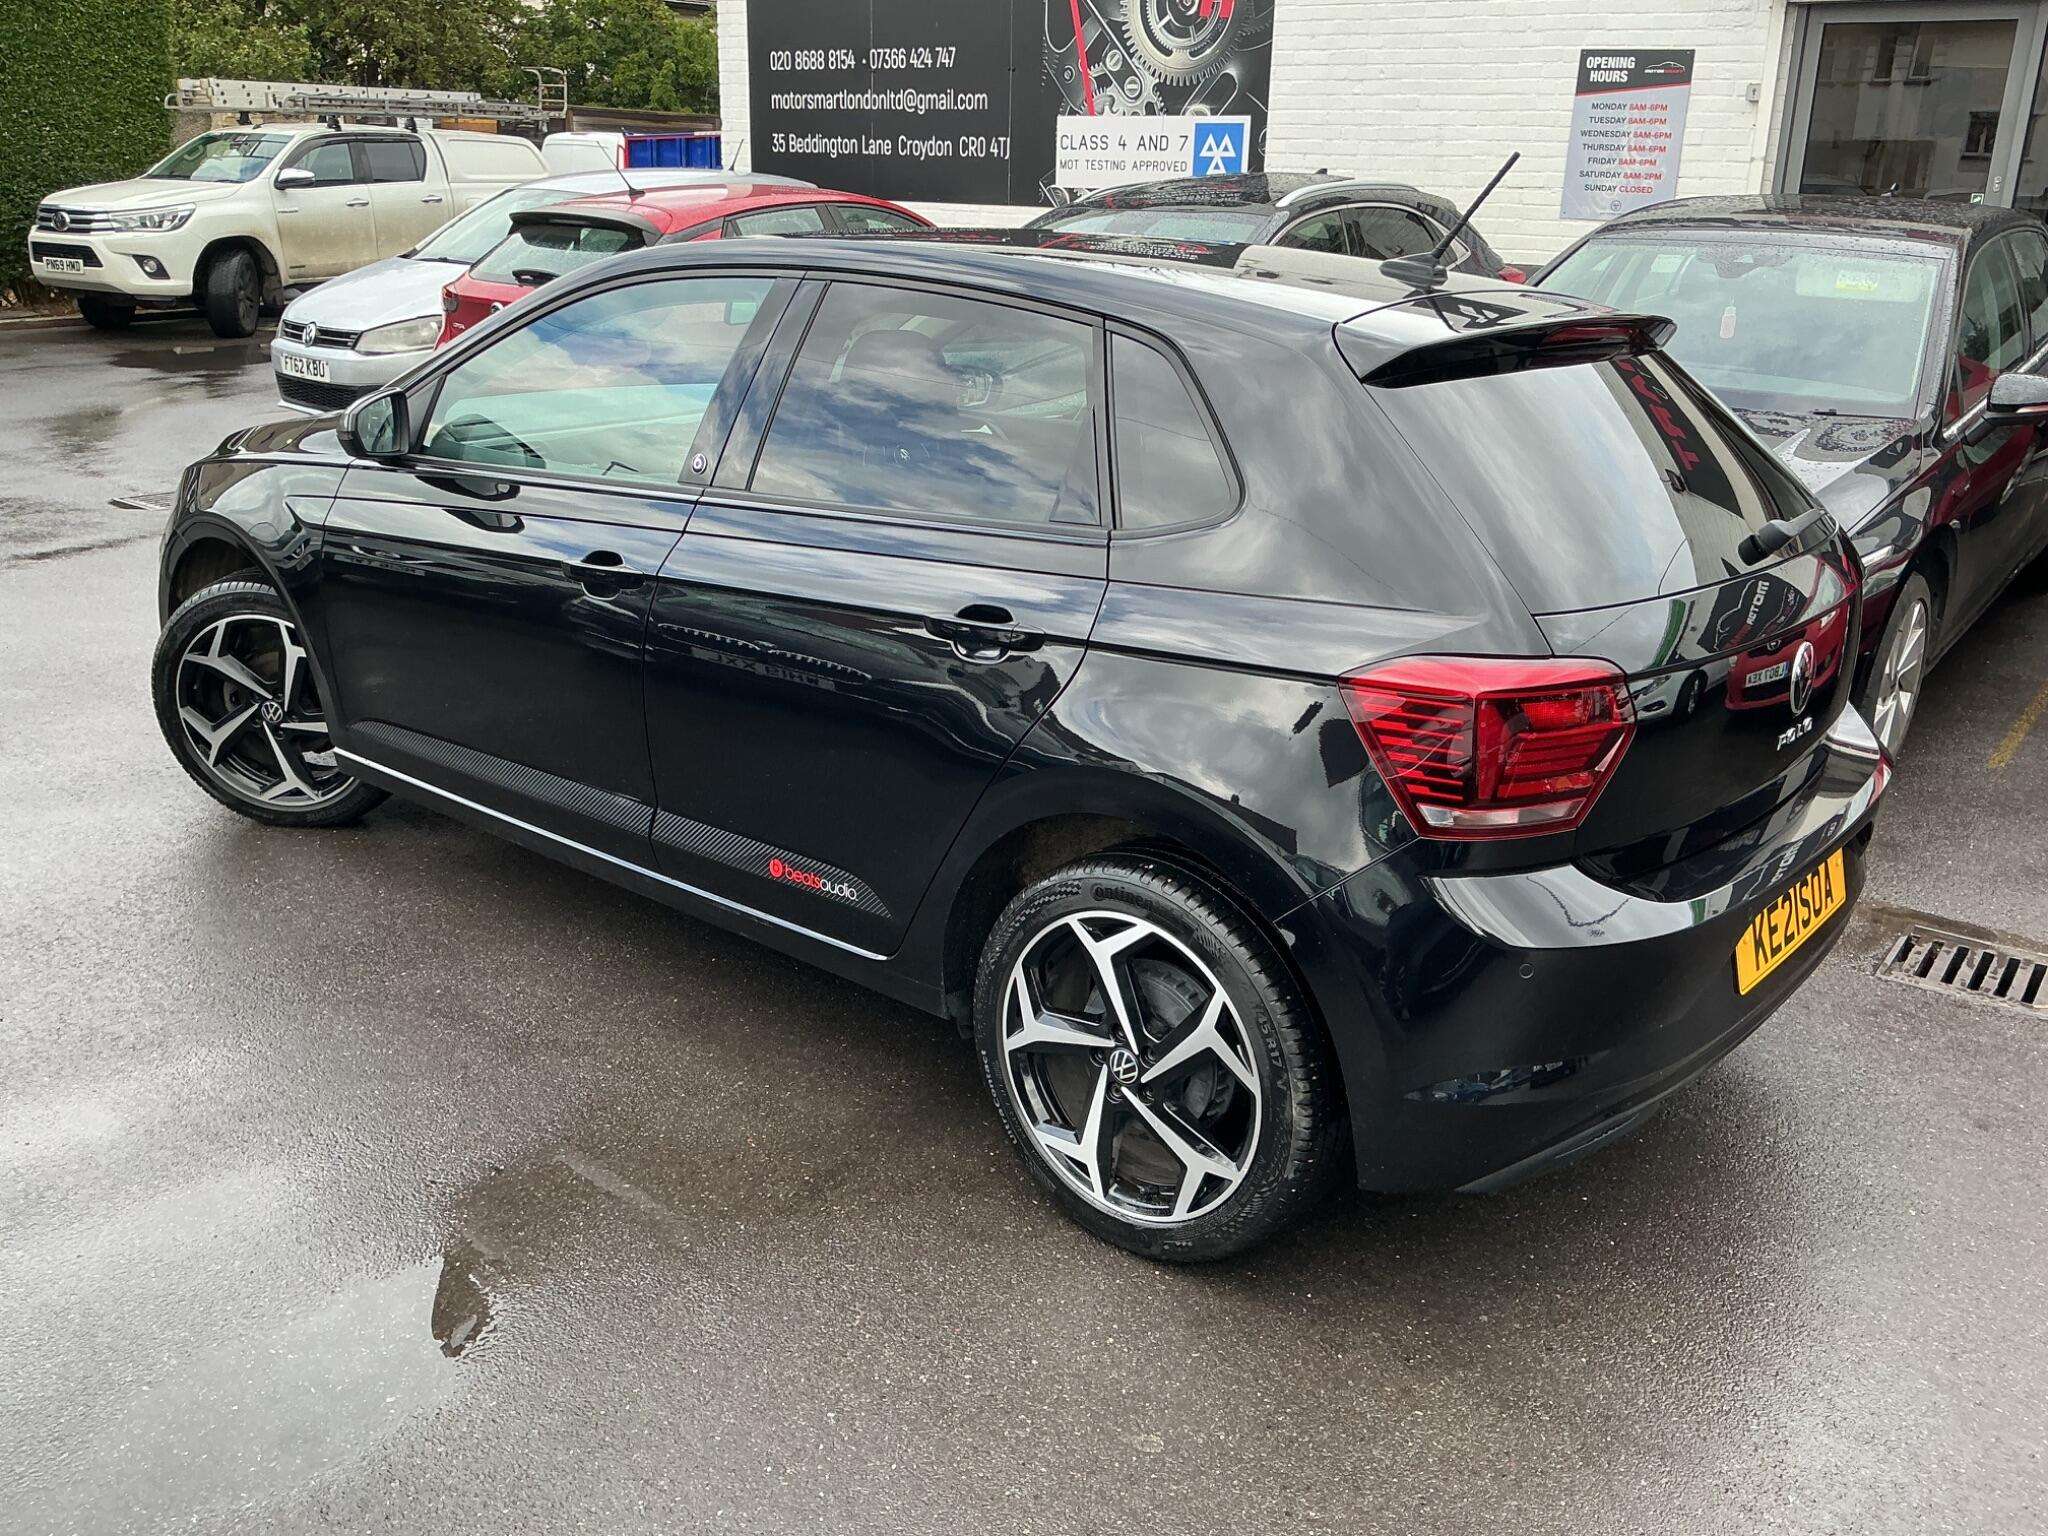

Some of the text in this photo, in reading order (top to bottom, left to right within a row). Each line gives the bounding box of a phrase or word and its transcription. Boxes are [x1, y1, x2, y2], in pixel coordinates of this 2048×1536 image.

[769, 46, 956, 70] 020 8688 8154 07366 424 747
[1586, 56, 1636, 69] OPENING
[1589, 70, 1629, 83] HOURS
[770, 88, 989, 115] motorsmartlondonltd@gmail.com
[1591, 102, 1627, 111] MONDAY
[1589, 116, 1627, 125] TUESDAY
[1580, 130, 1631, 138] WEDNESDAY
[771, 133, 786, 152] 35
[788, 134, 858, 158] Beddington
[861, 135, 892, 155] Lane
[898, 135, 953, 160] Croydon
[1059, 134, 1189, 151] CLASS 4 AND 7
[1583, 143, 1626, 152] THURSDAY
[1059, 159, 1188, 172] MOT TESTING APPROVED
[1588, 157, 1617, 165] FRIDAY
[1579, 170, 1621, 179] SATURDAY
[1584, 184, 1654, 194] SUNDAY CLOSED
[284, 355, 325, 378] FT62 KBU
